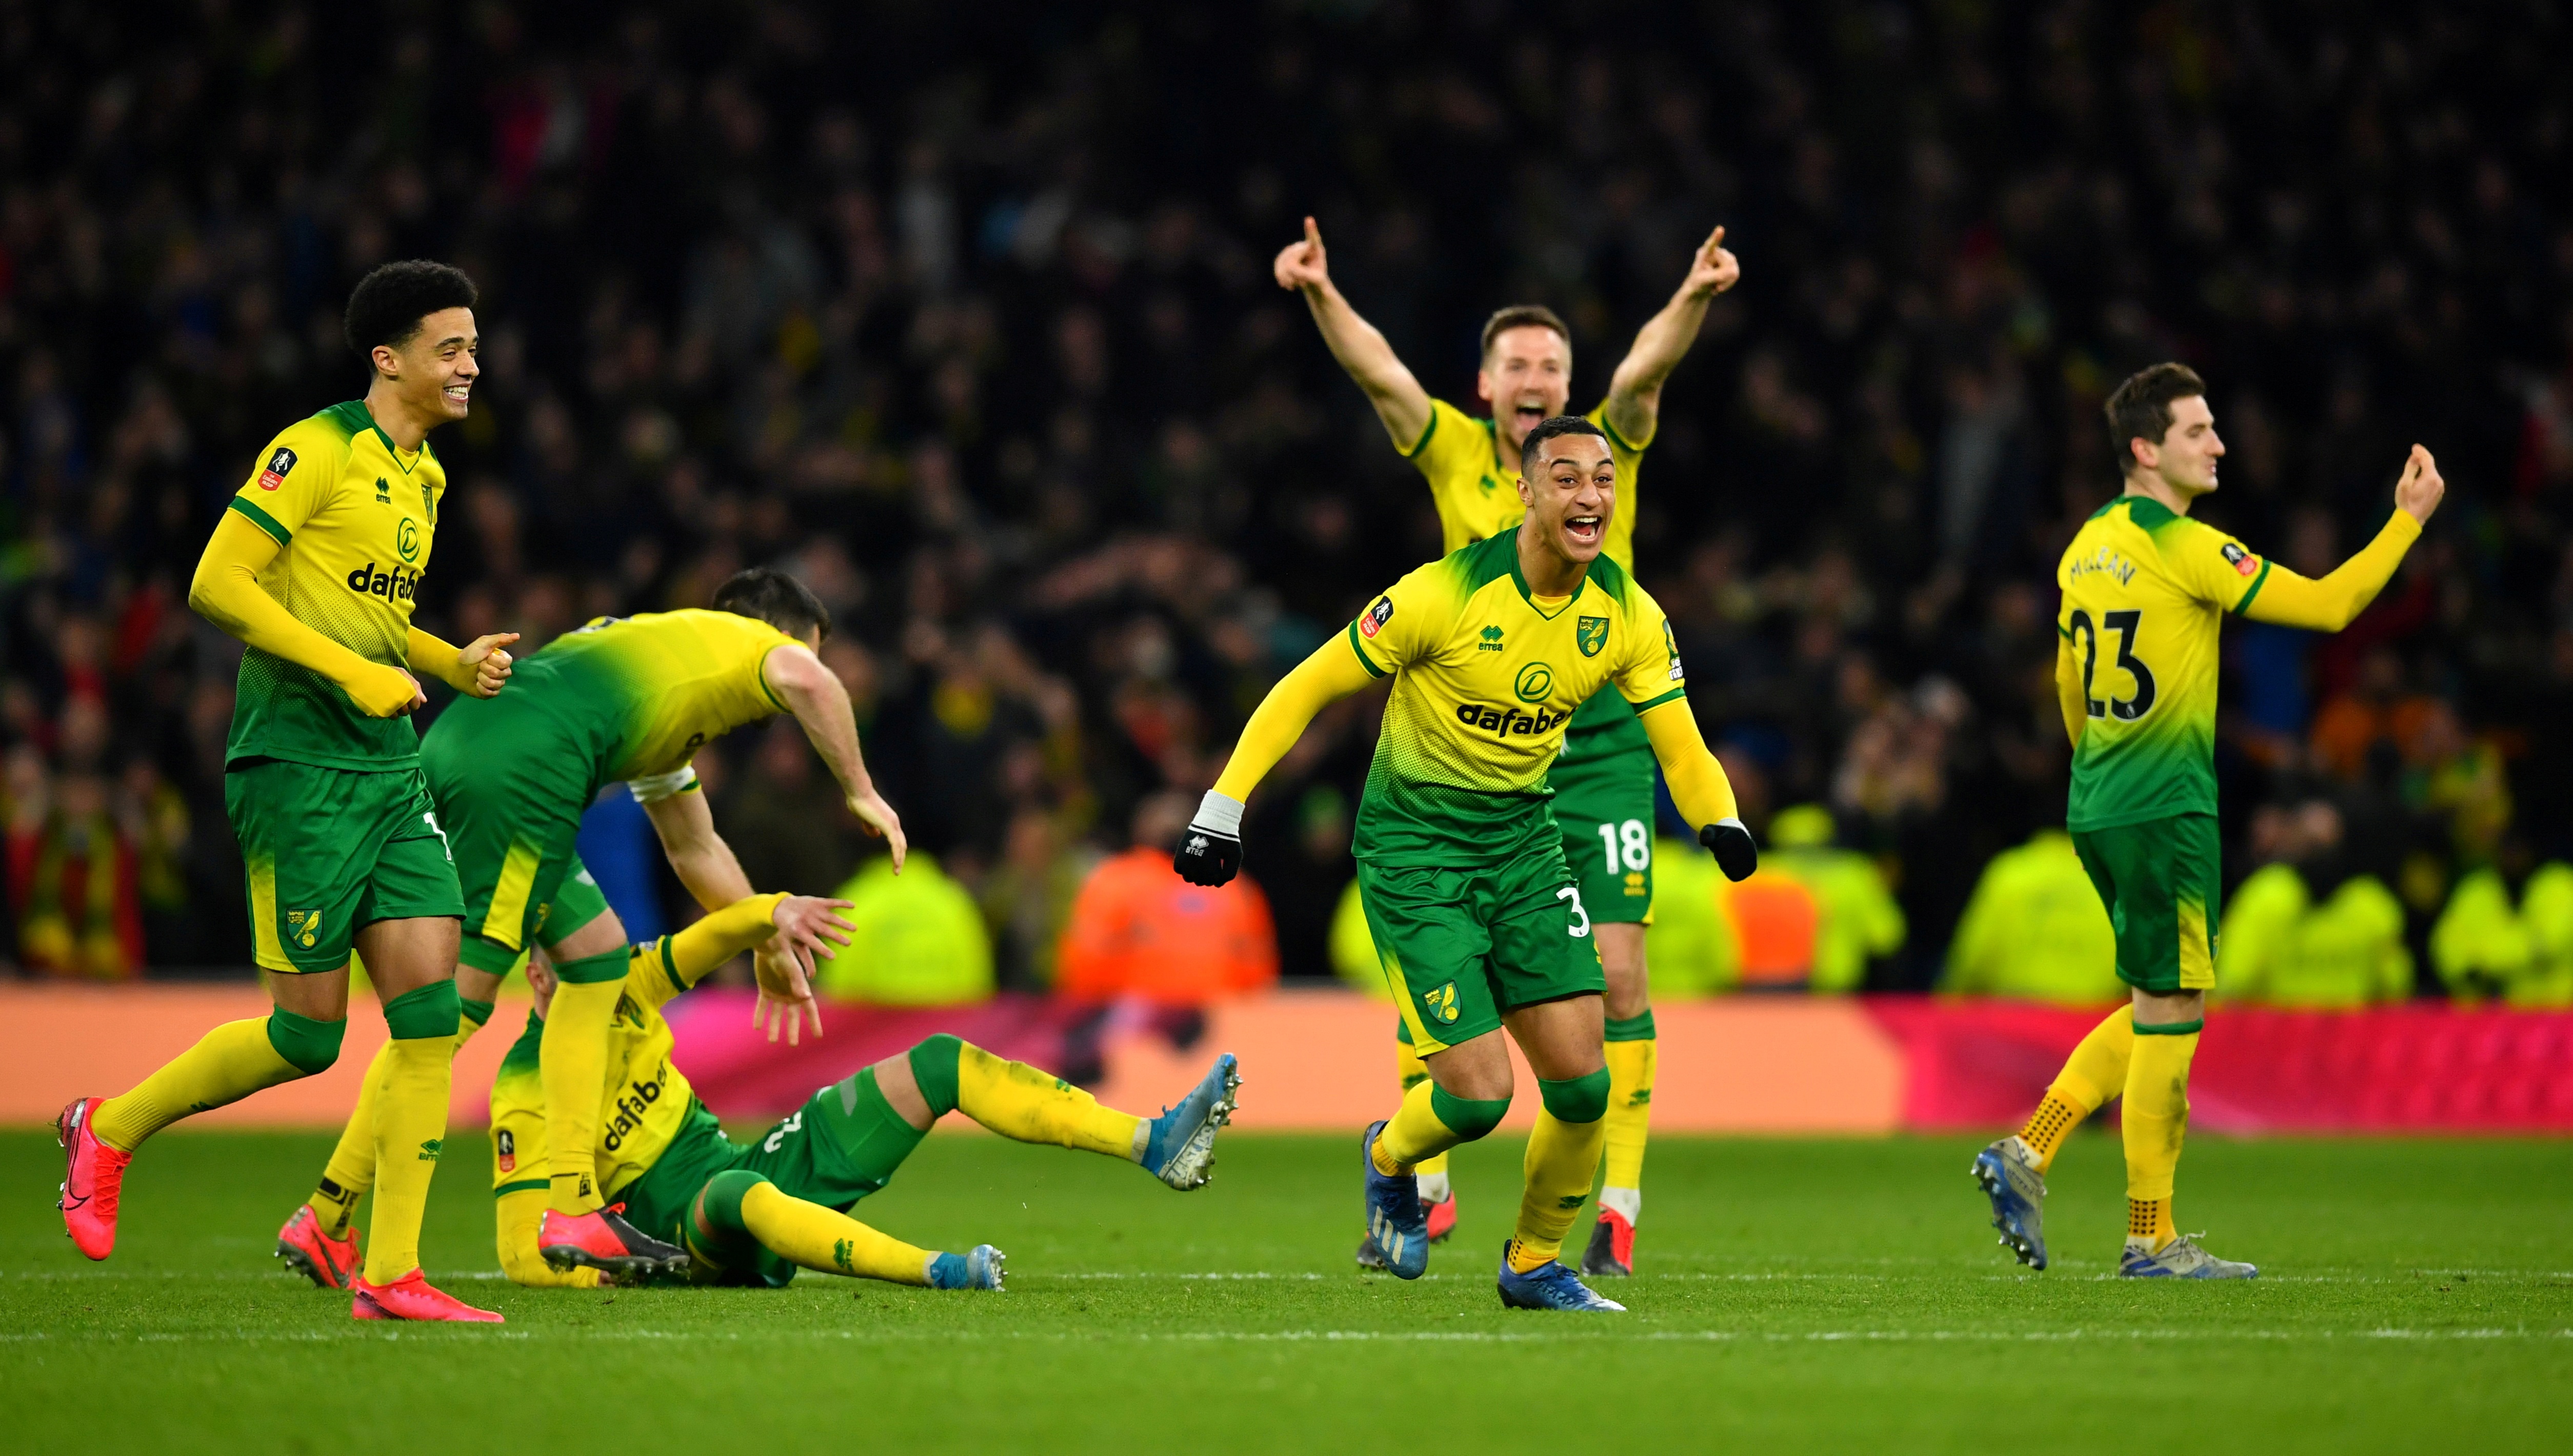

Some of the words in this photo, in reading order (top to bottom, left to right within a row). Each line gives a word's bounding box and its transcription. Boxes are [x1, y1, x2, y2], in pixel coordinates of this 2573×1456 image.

[376, 493, 391, 505] errea
[1479, 642, 1503, 652] errea
[2070, 608, 2157, 724] 23
[1598, 819, 1650, 874] 18
[1555, 887, 1590, 938] 3
